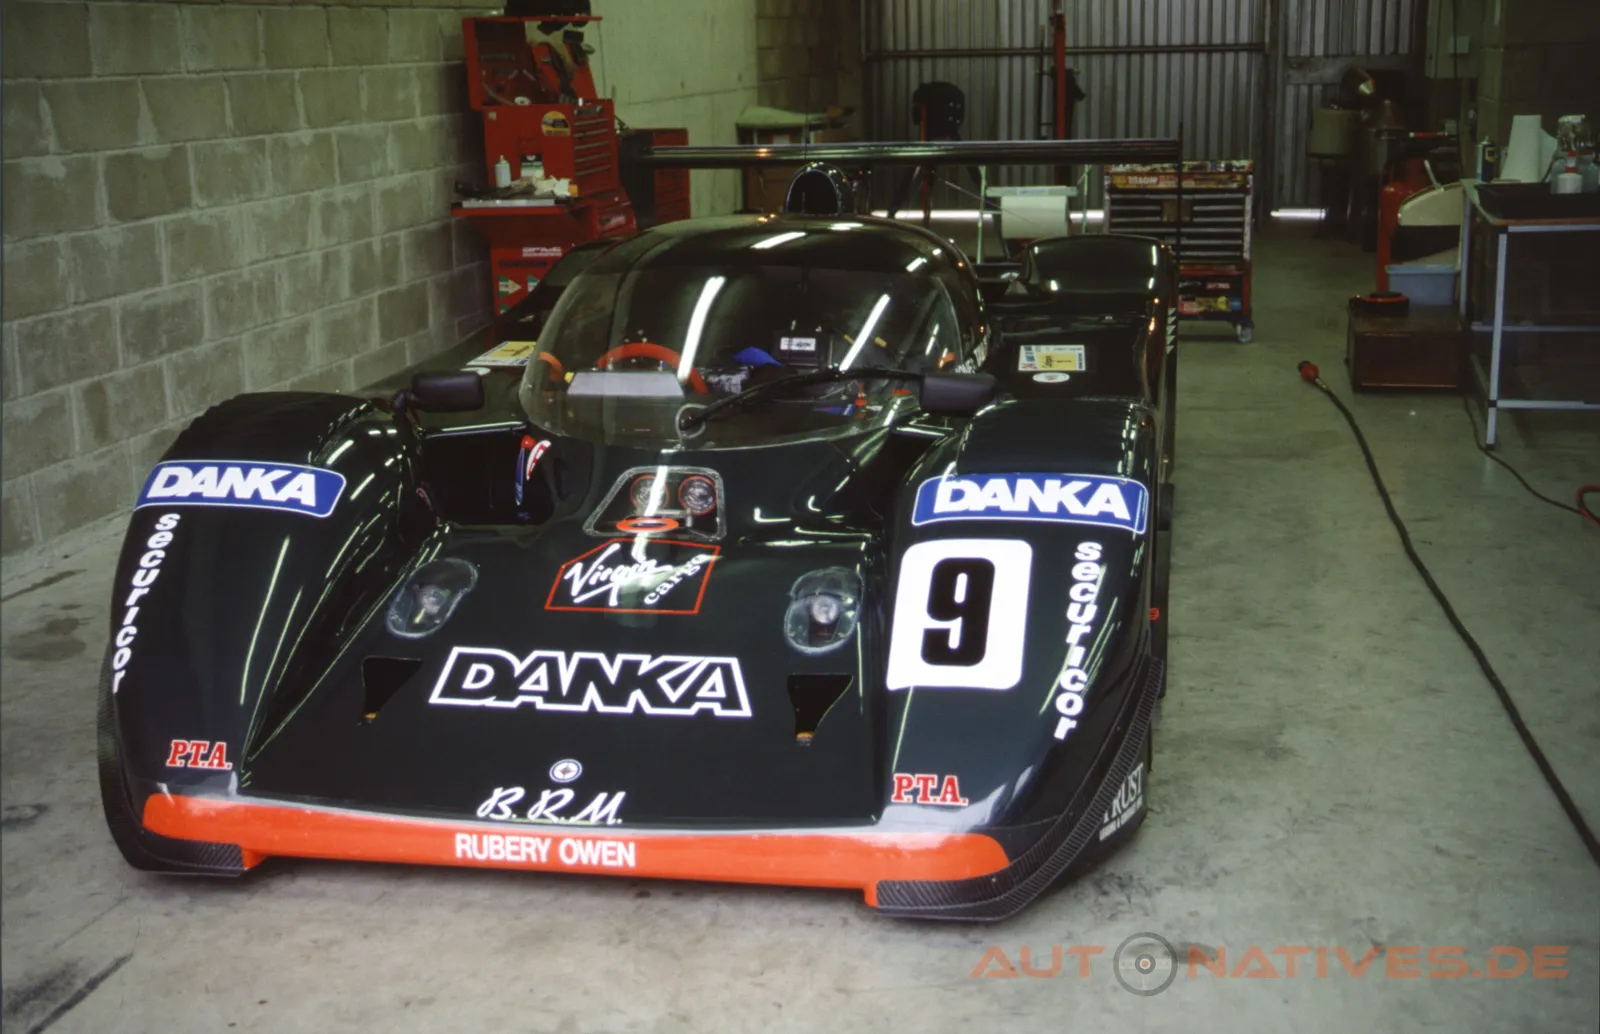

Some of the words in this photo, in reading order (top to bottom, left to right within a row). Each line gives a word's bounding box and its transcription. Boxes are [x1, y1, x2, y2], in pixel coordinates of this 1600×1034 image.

[147, 466, 316, 507] DANKA
[933, 478, 1131, 521] DANKA
[564, 542, 674, 607] Virgin
[644, 554, 706, 605] cargo
[112, 513, 181, 694] securicor
[920, 557, 996, 667] 9
[1053, 541, 1103, 740] securicor
[428, 646, 752, 717] DANKA
[166, 739, 233, 770] P.T.A.
[891, 773, 969, 806] P.T.A.
[1103, 761, 1144, 823] RUST
[455, 833, 551, 863] RUBERY
[559, 838, 637, 868] OWEN
